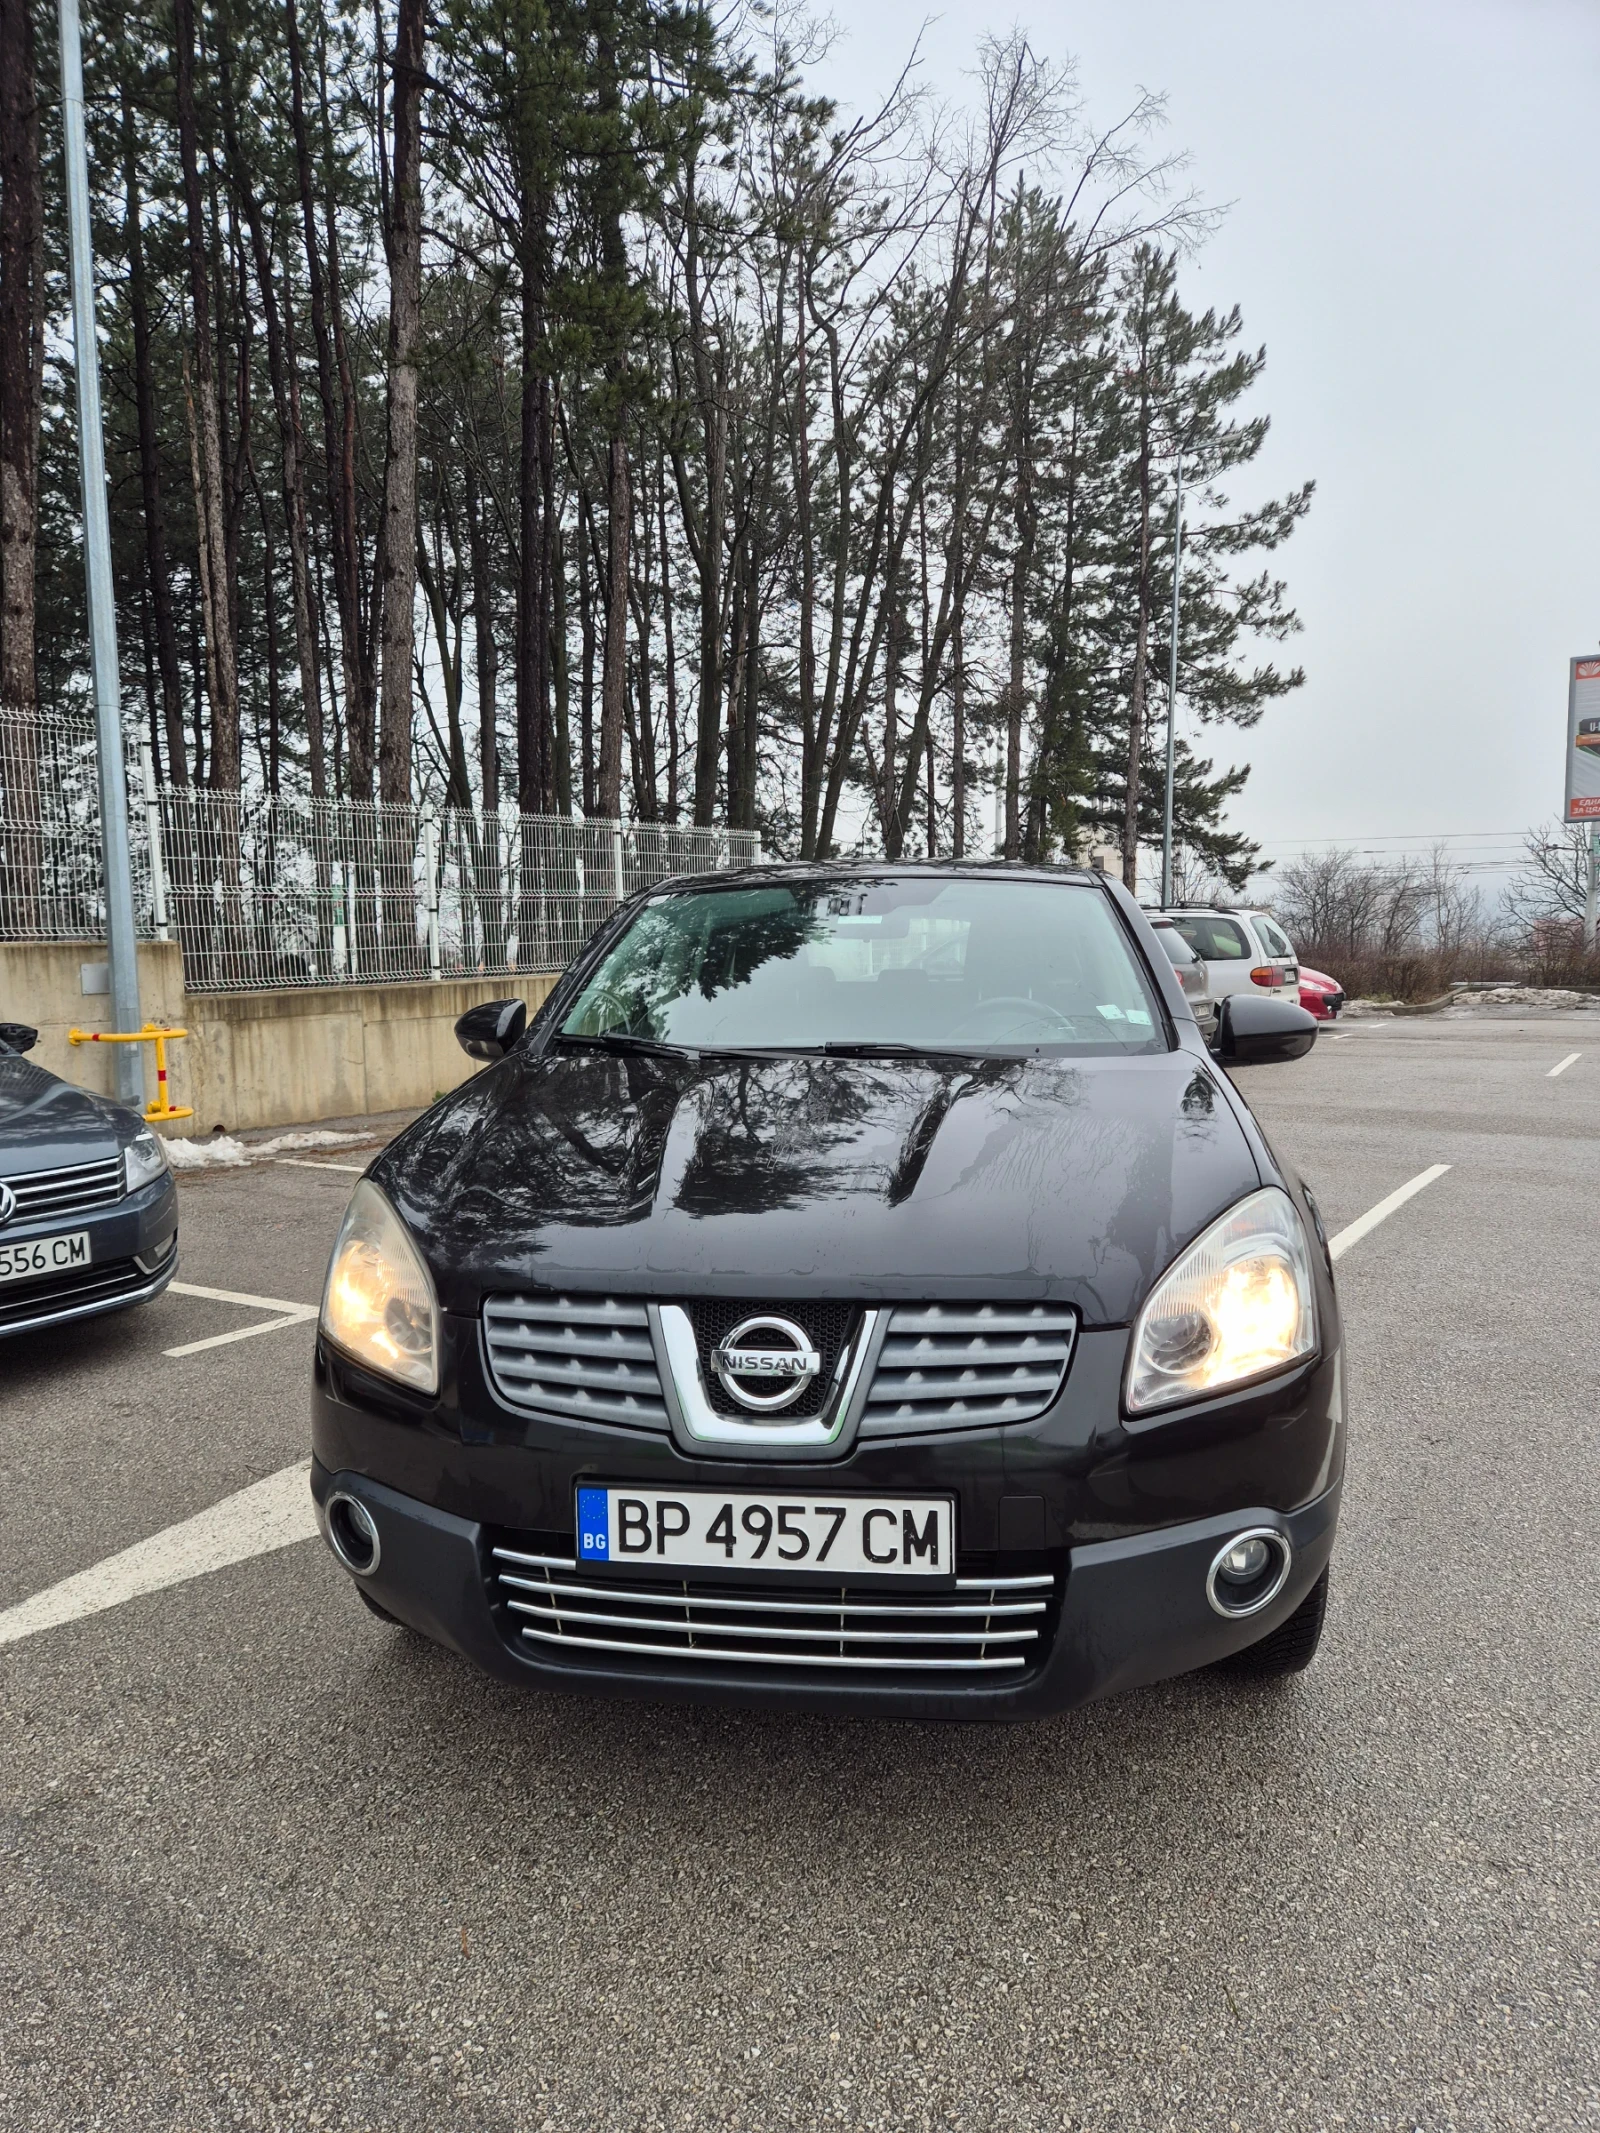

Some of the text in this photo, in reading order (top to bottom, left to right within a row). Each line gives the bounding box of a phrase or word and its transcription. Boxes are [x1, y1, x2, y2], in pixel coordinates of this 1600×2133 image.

[1589, 721, 1600, 732] U-
[0, 1236, 86, 1276] 556 CM
[722, 1355, 807, 1371] NISSAN
[617, 1498, 939, 1565] BP 4957 CM
[583, 1533, 606, 1549] BG
